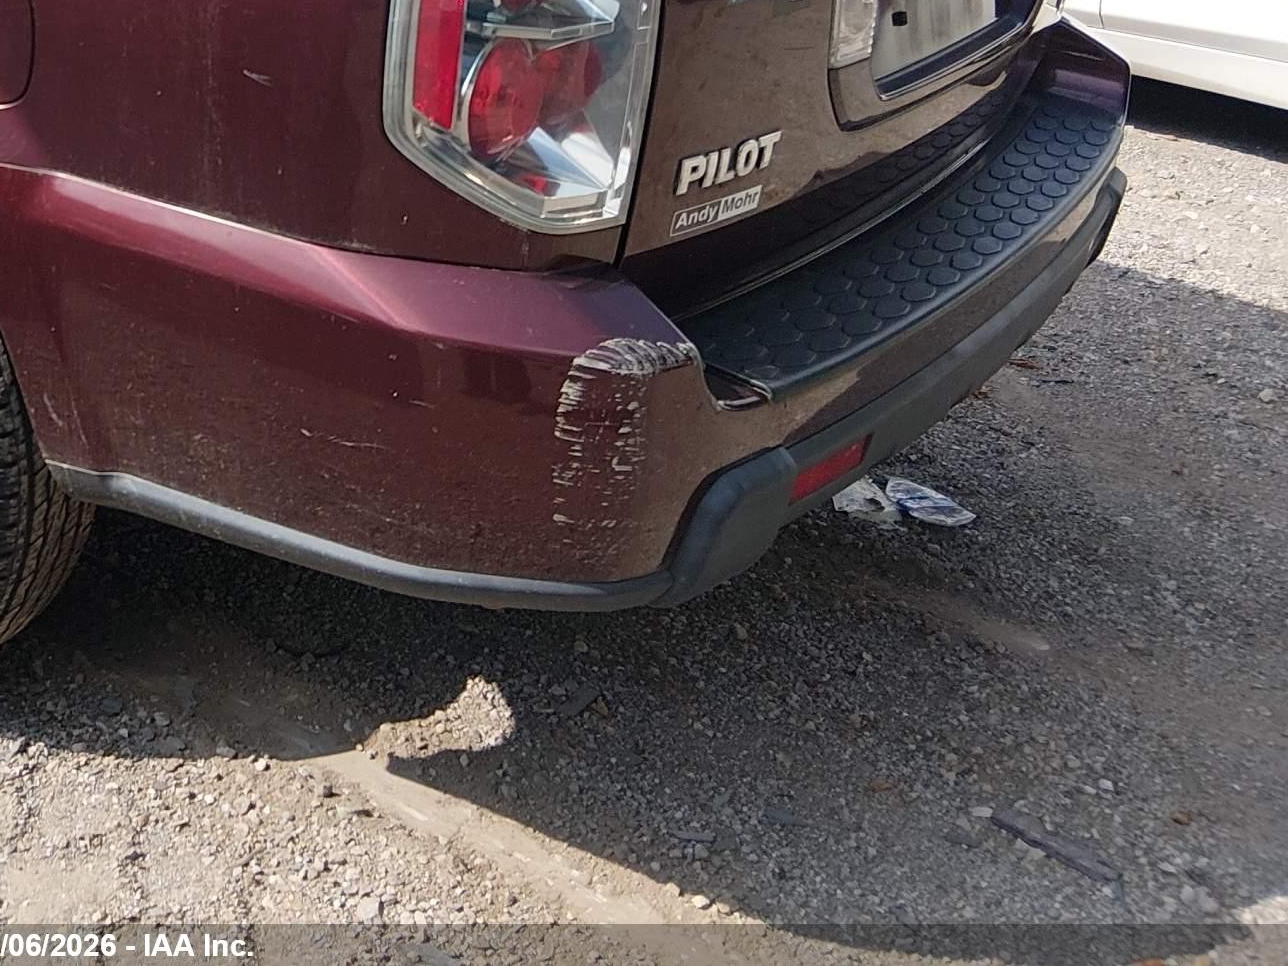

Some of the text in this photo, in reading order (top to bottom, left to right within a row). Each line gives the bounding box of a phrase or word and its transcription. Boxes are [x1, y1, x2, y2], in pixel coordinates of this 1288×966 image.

[673, 130, 784, 196] PILOT
[675, 191, 760, 230] Andy Mohr
